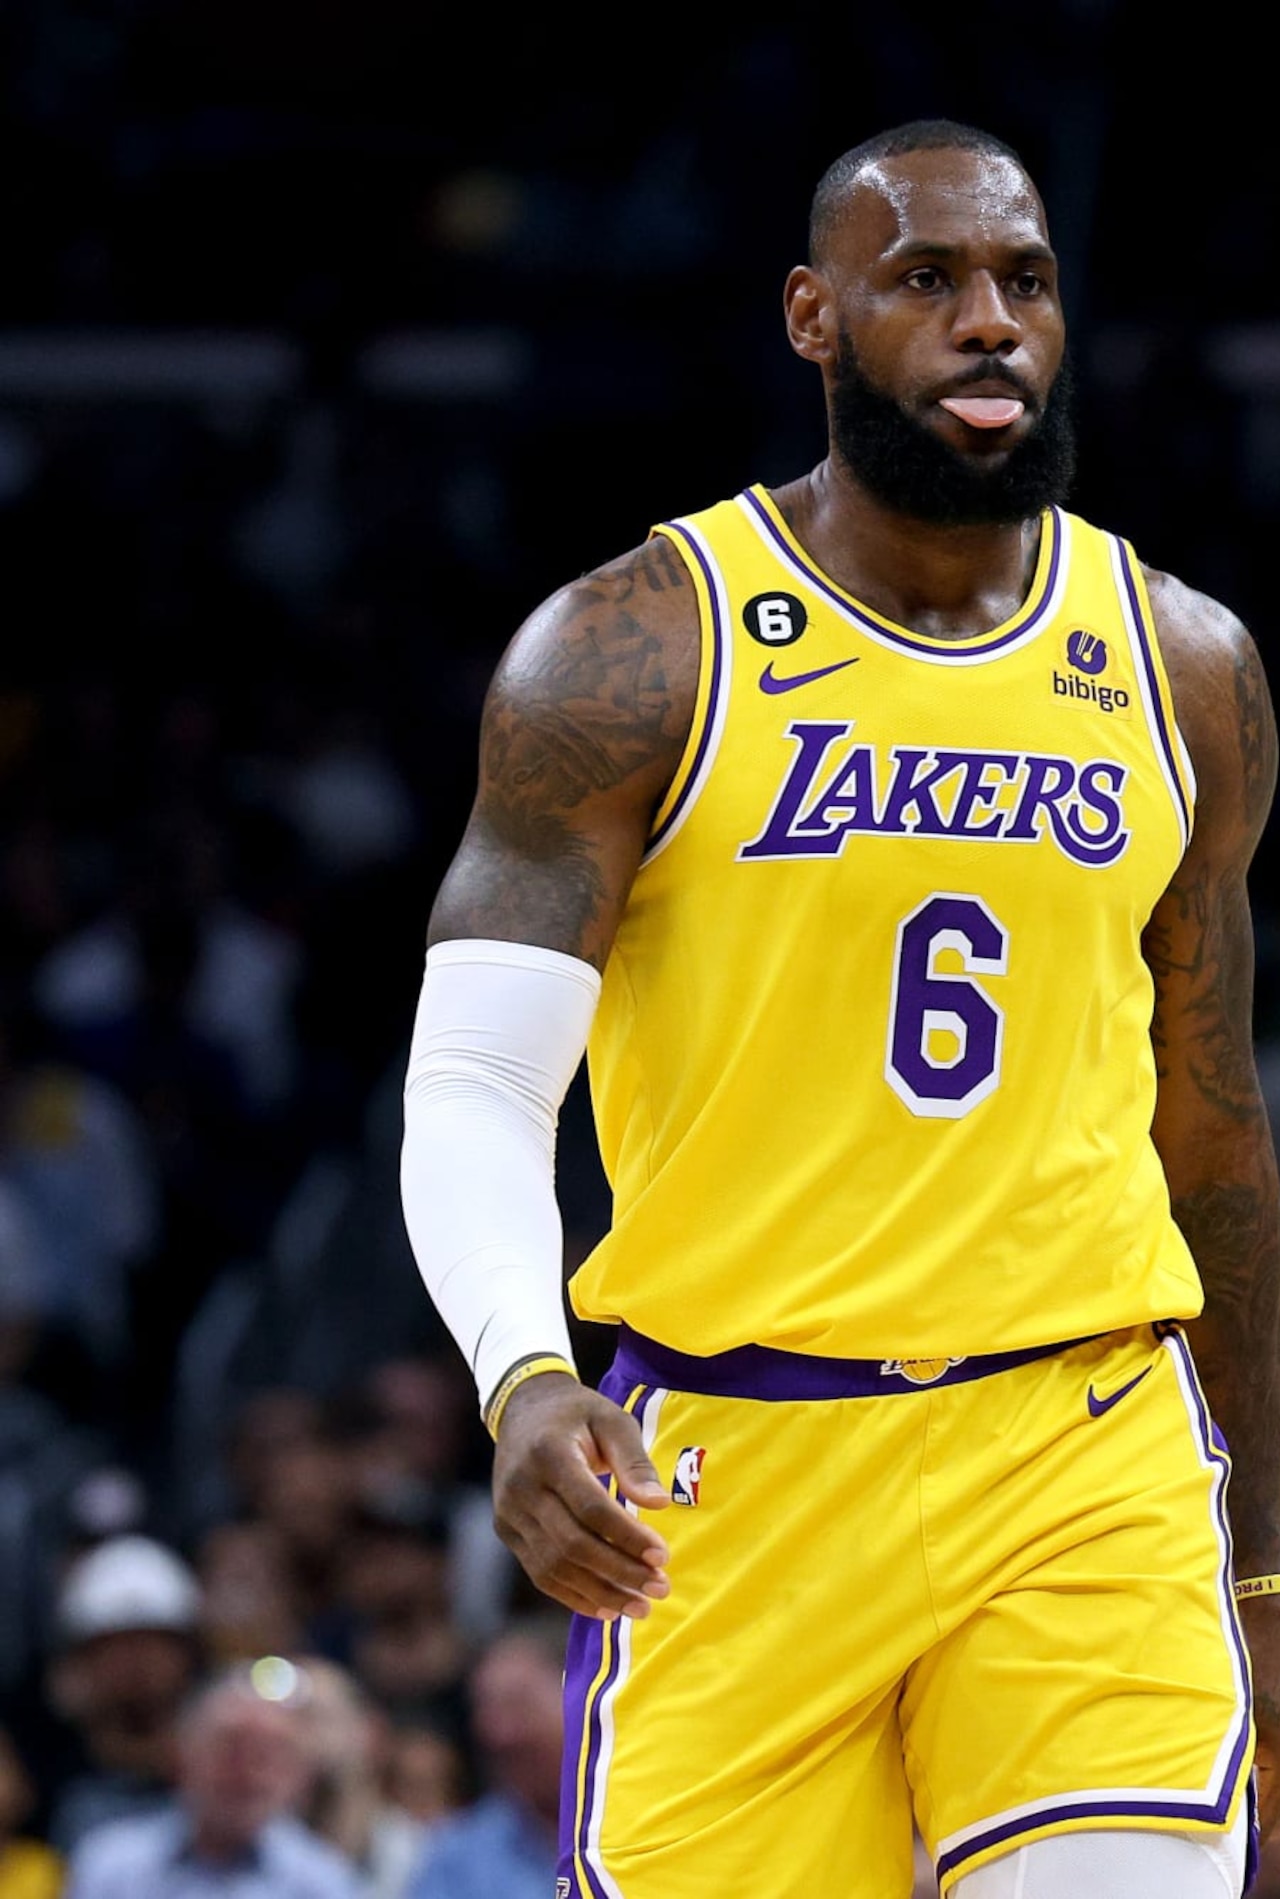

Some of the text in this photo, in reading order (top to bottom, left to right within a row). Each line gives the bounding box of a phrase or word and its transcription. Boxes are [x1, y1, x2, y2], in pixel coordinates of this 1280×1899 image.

[757, 600, 793, 641] 6
[1052, 671, 1129, 712] bibigo
[736, 718, 1132, 868] LAKERS
[884, 891, 1010, 1120] 6
